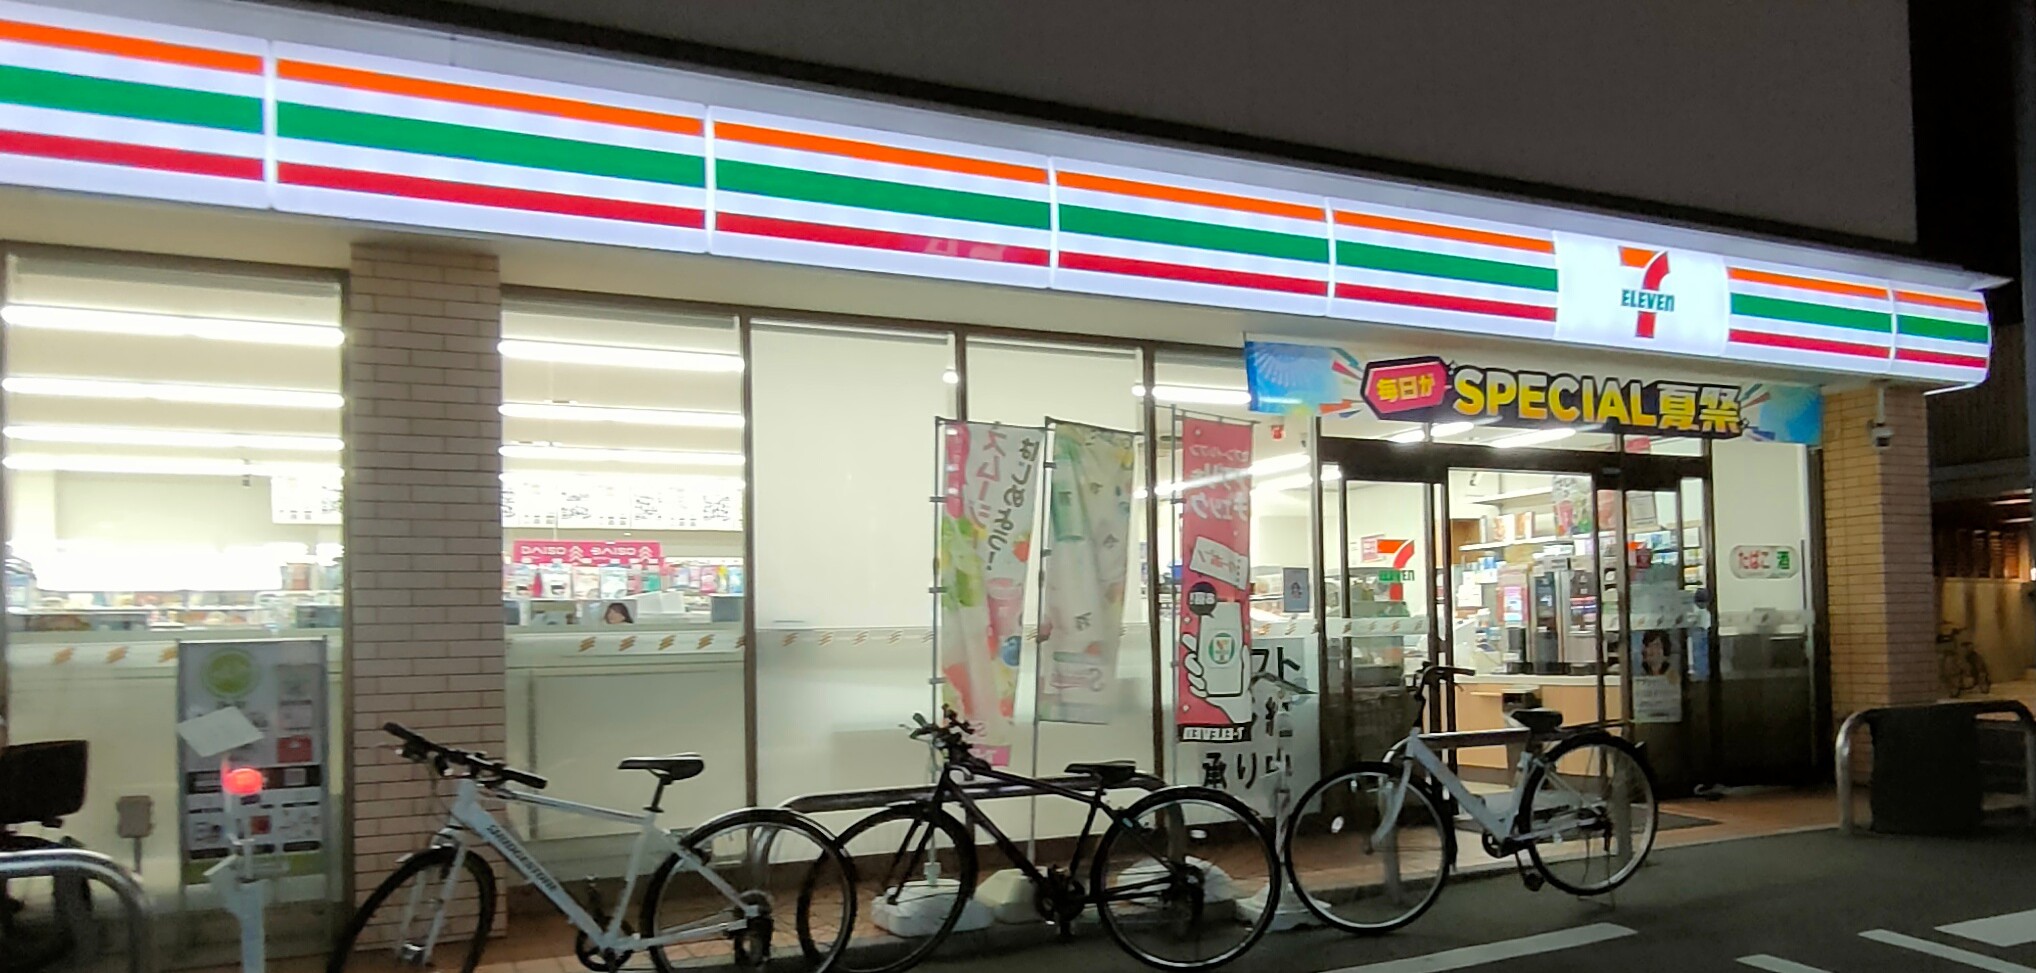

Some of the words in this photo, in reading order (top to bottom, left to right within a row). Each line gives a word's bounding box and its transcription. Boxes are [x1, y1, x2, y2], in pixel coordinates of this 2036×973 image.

[1618, 245, 1670, 338] 7
[1376, 373, 1436, 403] 毎日が
[520, 545, 567, 556] DAISO
[1377, 539, 1415, 602] 7
